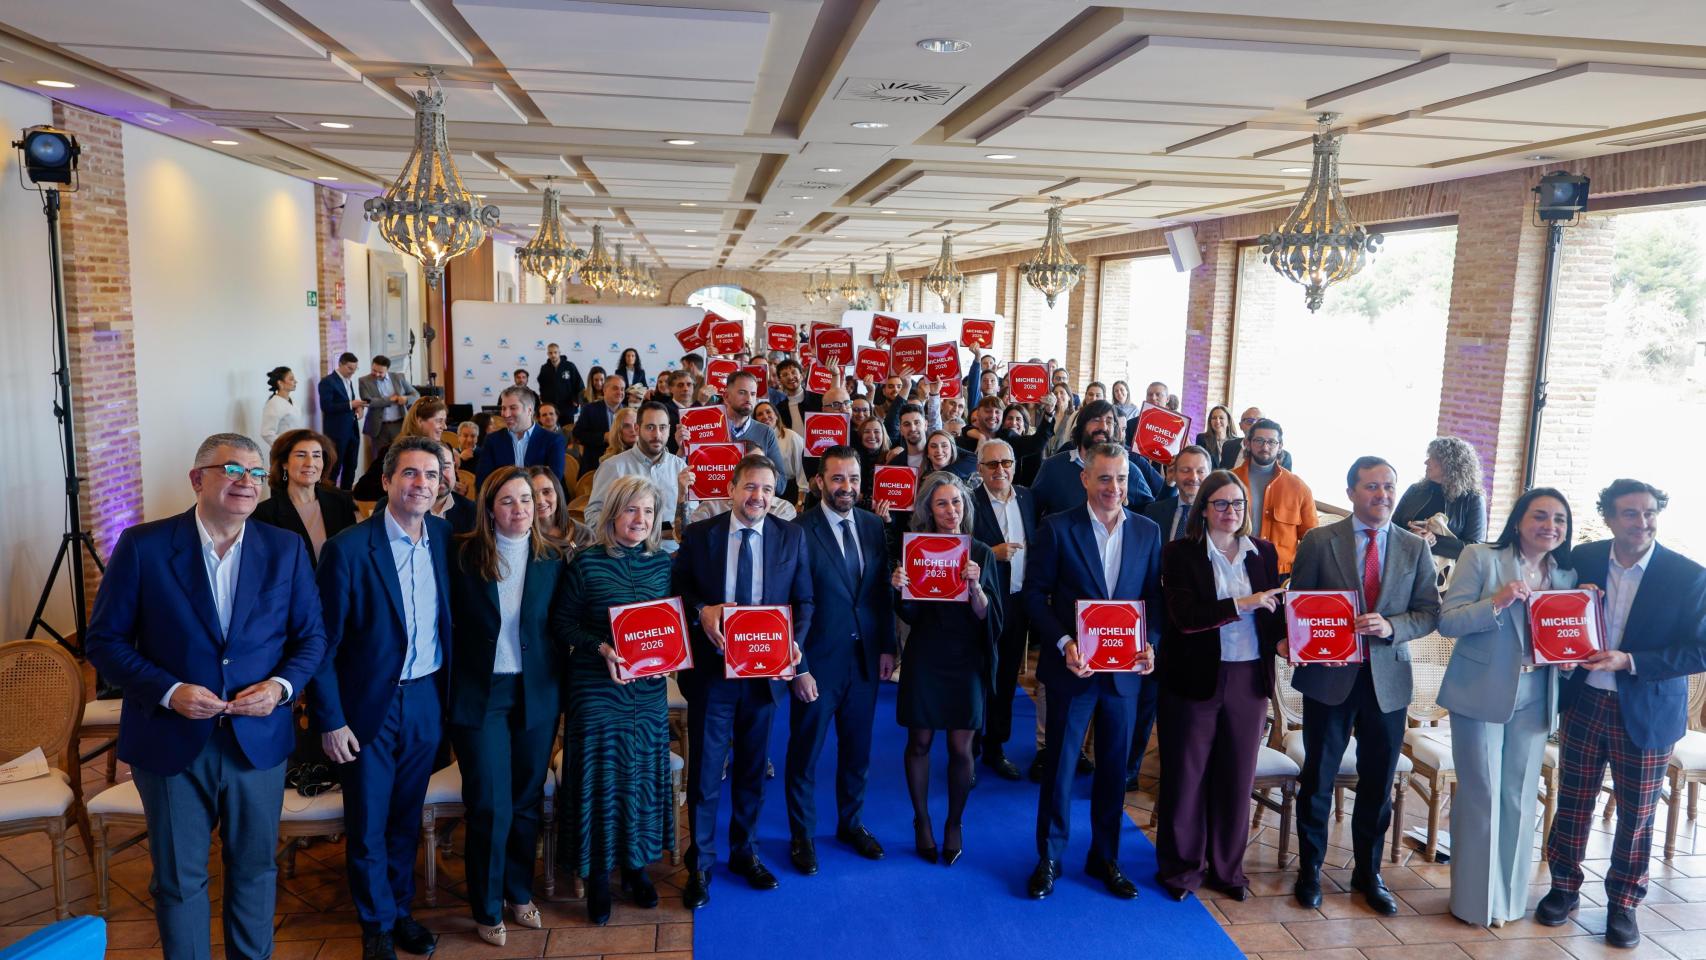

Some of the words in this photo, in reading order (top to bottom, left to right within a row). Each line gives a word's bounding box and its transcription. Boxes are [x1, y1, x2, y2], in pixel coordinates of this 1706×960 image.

[561, 314, 603, 324] CaixaBank
[912, 321, 947, 330] CaixaBank
[861, 359, 885, 367] MICHELIN
[688, 422, 721, 432] MICHELIN
[811, 428, 843, 436] MICHELIN
[913, 558, 960, 568] MICHELIN
[925, 569, 947, 578] 2026
[1297, 617, 1348, 627] MICHELIN
[624, 625, 675, 642] MICHELIN
[1088, 627, 1136, 636] MICHELIN
[1312, 629, 1336, 638] 2026
[1557, 628, 1580, 638] 2026
[734, 632, 783, 642] MICHELIN
[640, 639, 664, 651] 2026
[1102, 638, 1124, 647] 2026
[748, 643, 771, 653] 2026
